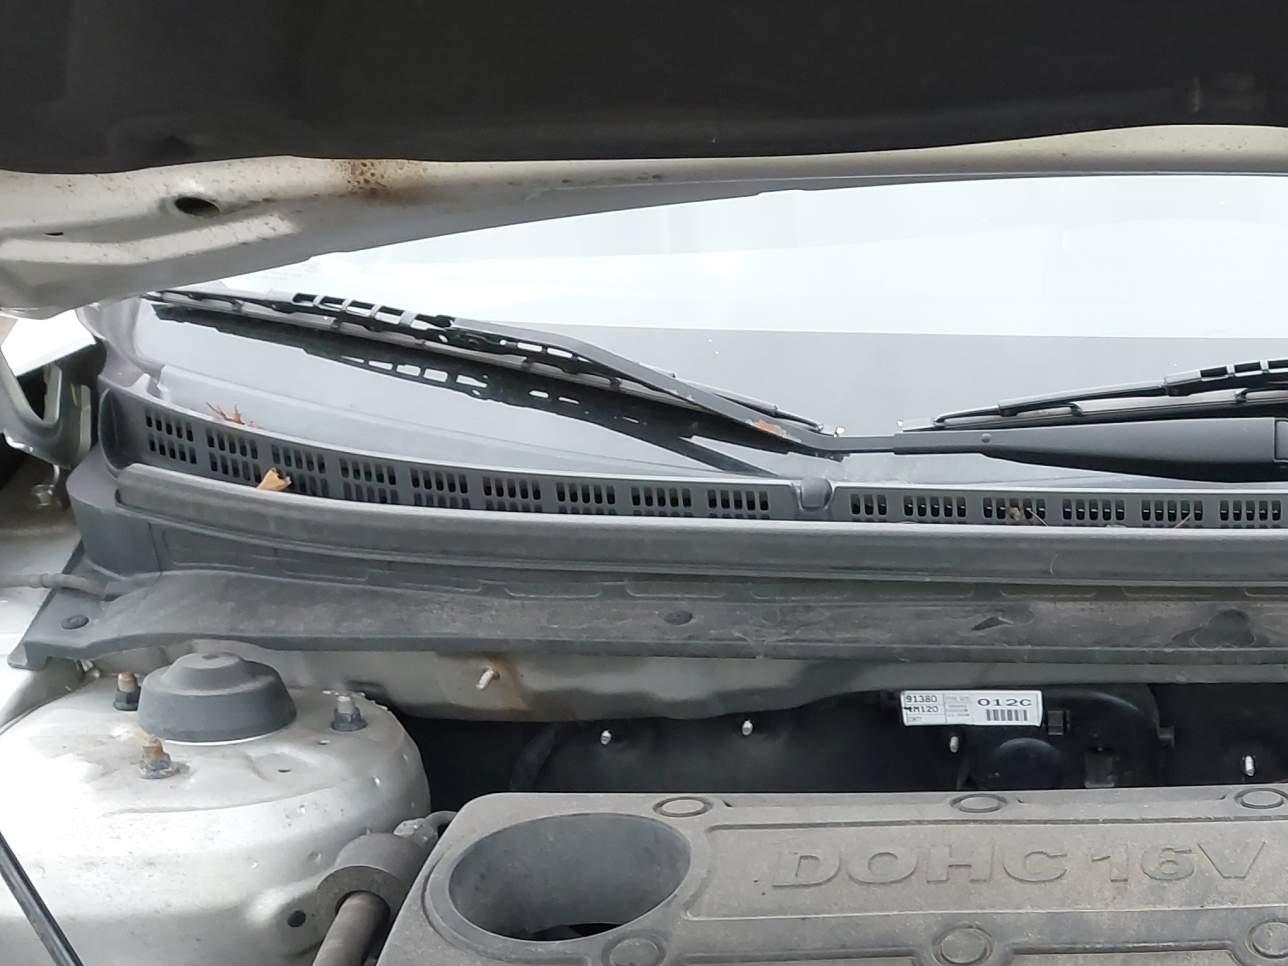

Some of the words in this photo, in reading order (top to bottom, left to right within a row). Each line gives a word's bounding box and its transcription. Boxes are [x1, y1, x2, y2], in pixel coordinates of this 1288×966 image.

[977, 698, 1033, 707] 012C
[769, 842, 1069, 889] DOHC
[1091, 839, 1268, 884] 16V
